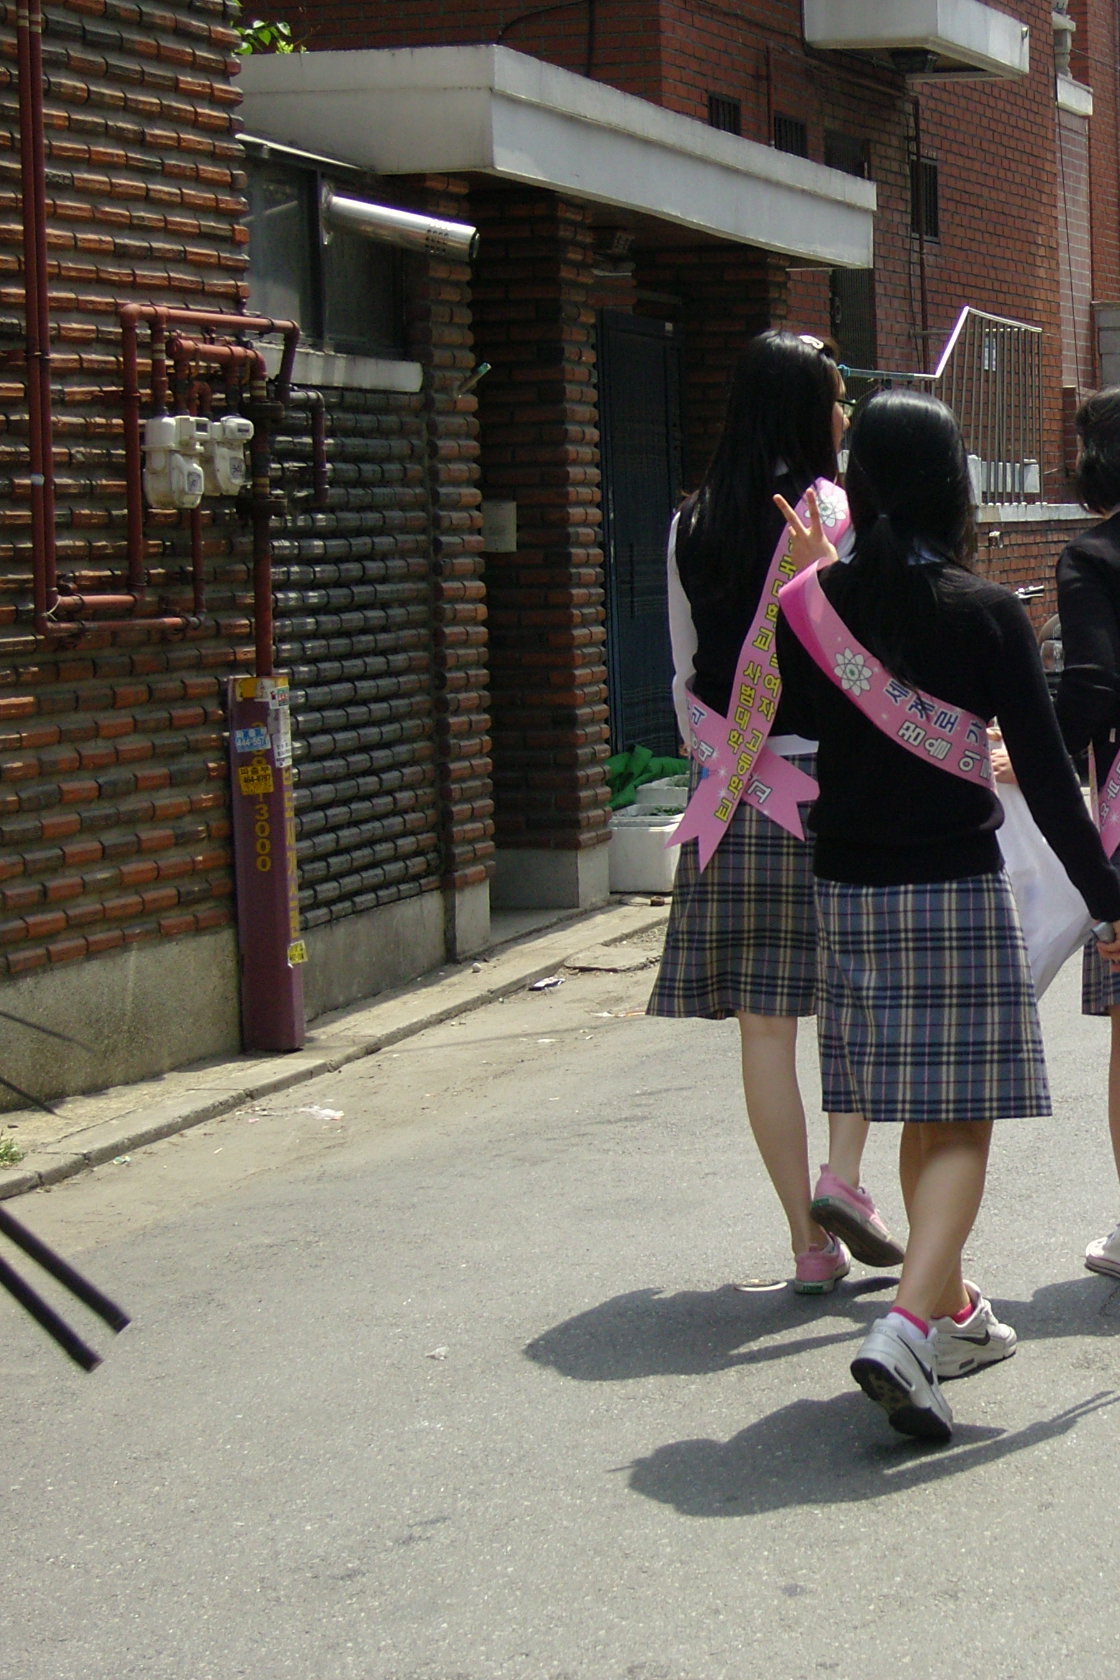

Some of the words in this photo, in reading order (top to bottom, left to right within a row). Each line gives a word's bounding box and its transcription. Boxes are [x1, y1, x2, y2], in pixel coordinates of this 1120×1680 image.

[727, 660, 762, 754] 사범대학
[883, 677, 959, 735] 세계로
[897, 719, 952, 760] 꿈을
[714, 728, 764, 823] 고등학교
